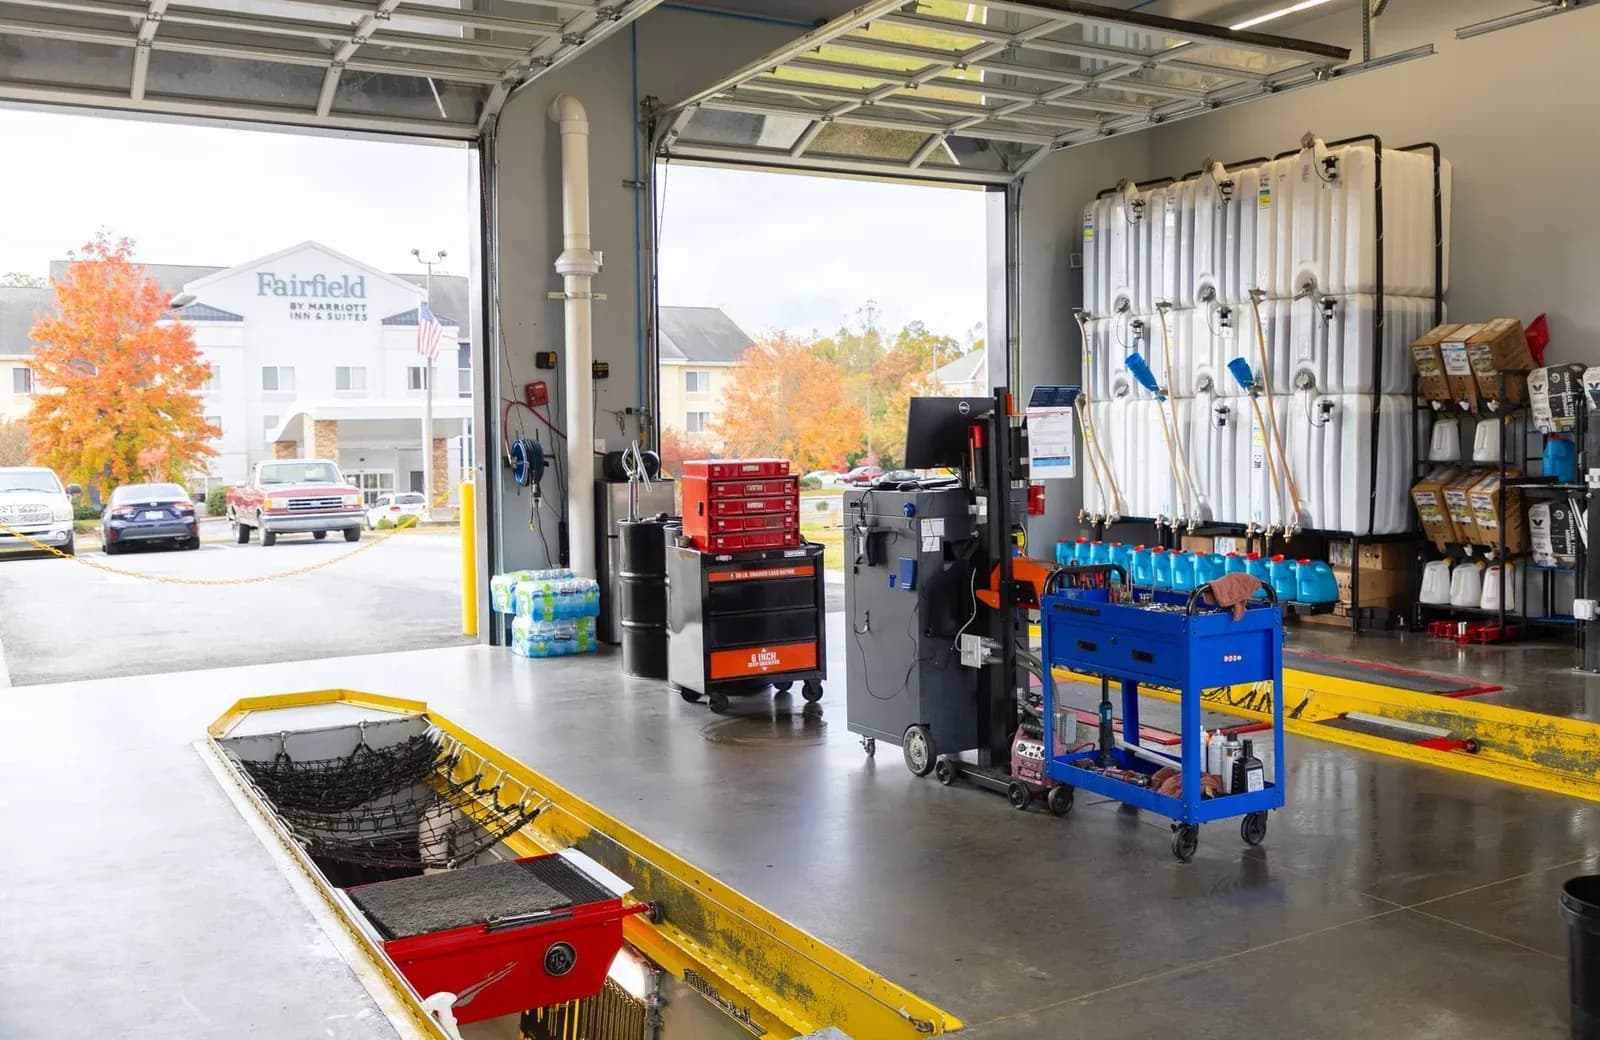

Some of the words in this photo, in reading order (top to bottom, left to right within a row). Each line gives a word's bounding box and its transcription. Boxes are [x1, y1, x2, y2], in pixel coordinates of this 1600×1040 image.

[256, 272, 367, 298] Fairfield
[290, 302, 304, 310] BY
[308, 302, 367, 312] MARRIOTT
[290, 311, 311, 320] INN
[315, 312, 322, 321] &
[327, 312, 368, 322] SUITES
[758, 652, 776, 661] INCH
